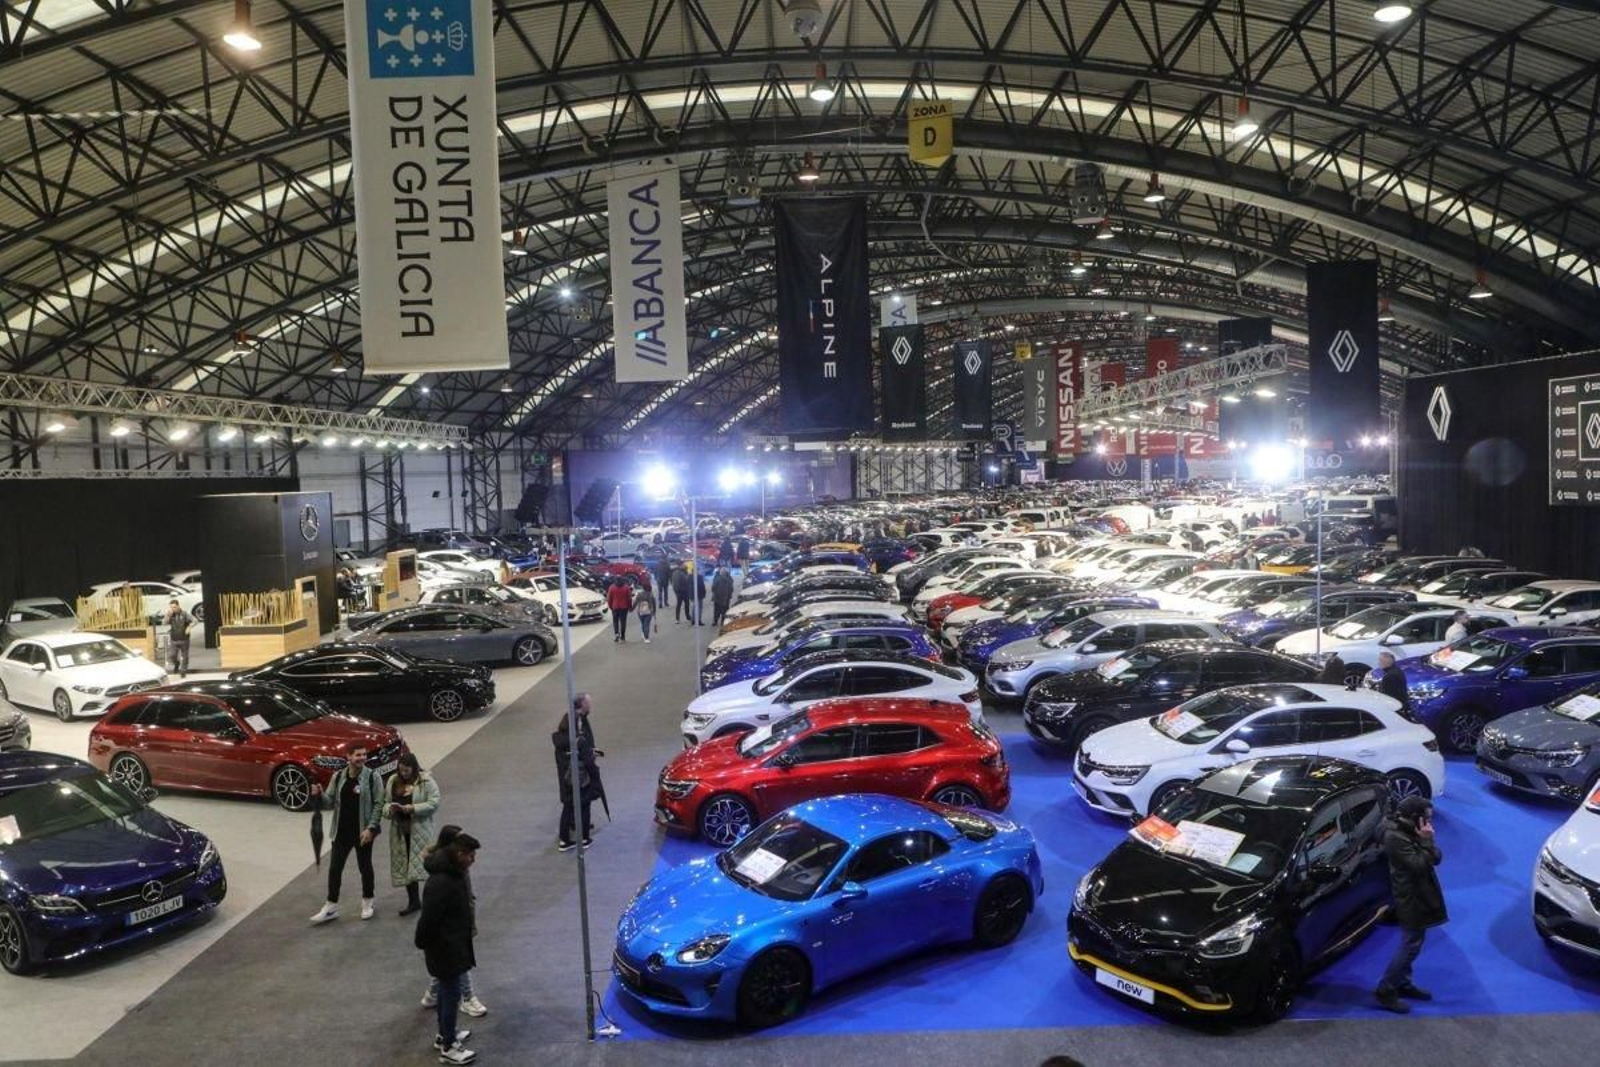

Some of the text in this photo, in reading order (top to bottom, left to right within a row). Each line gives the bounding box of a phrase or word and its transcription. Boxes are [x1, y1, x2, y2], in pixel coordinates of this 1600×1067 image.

[913, 104, 947, 118] ZONA
[923, 126, 937, 147] D
[433, 95, 475, 243] XUNTA
[389, 95, 435, 338] DE GALICIA
[820, 253, 837, 379] ALPINE
[1036, 369, 1046, 428] DACIA
[1058, 348, 1075, 450] NISSAN
[135, 898, 181, 921] 1020 LJV
[1117, 979, 1143, 997] new
